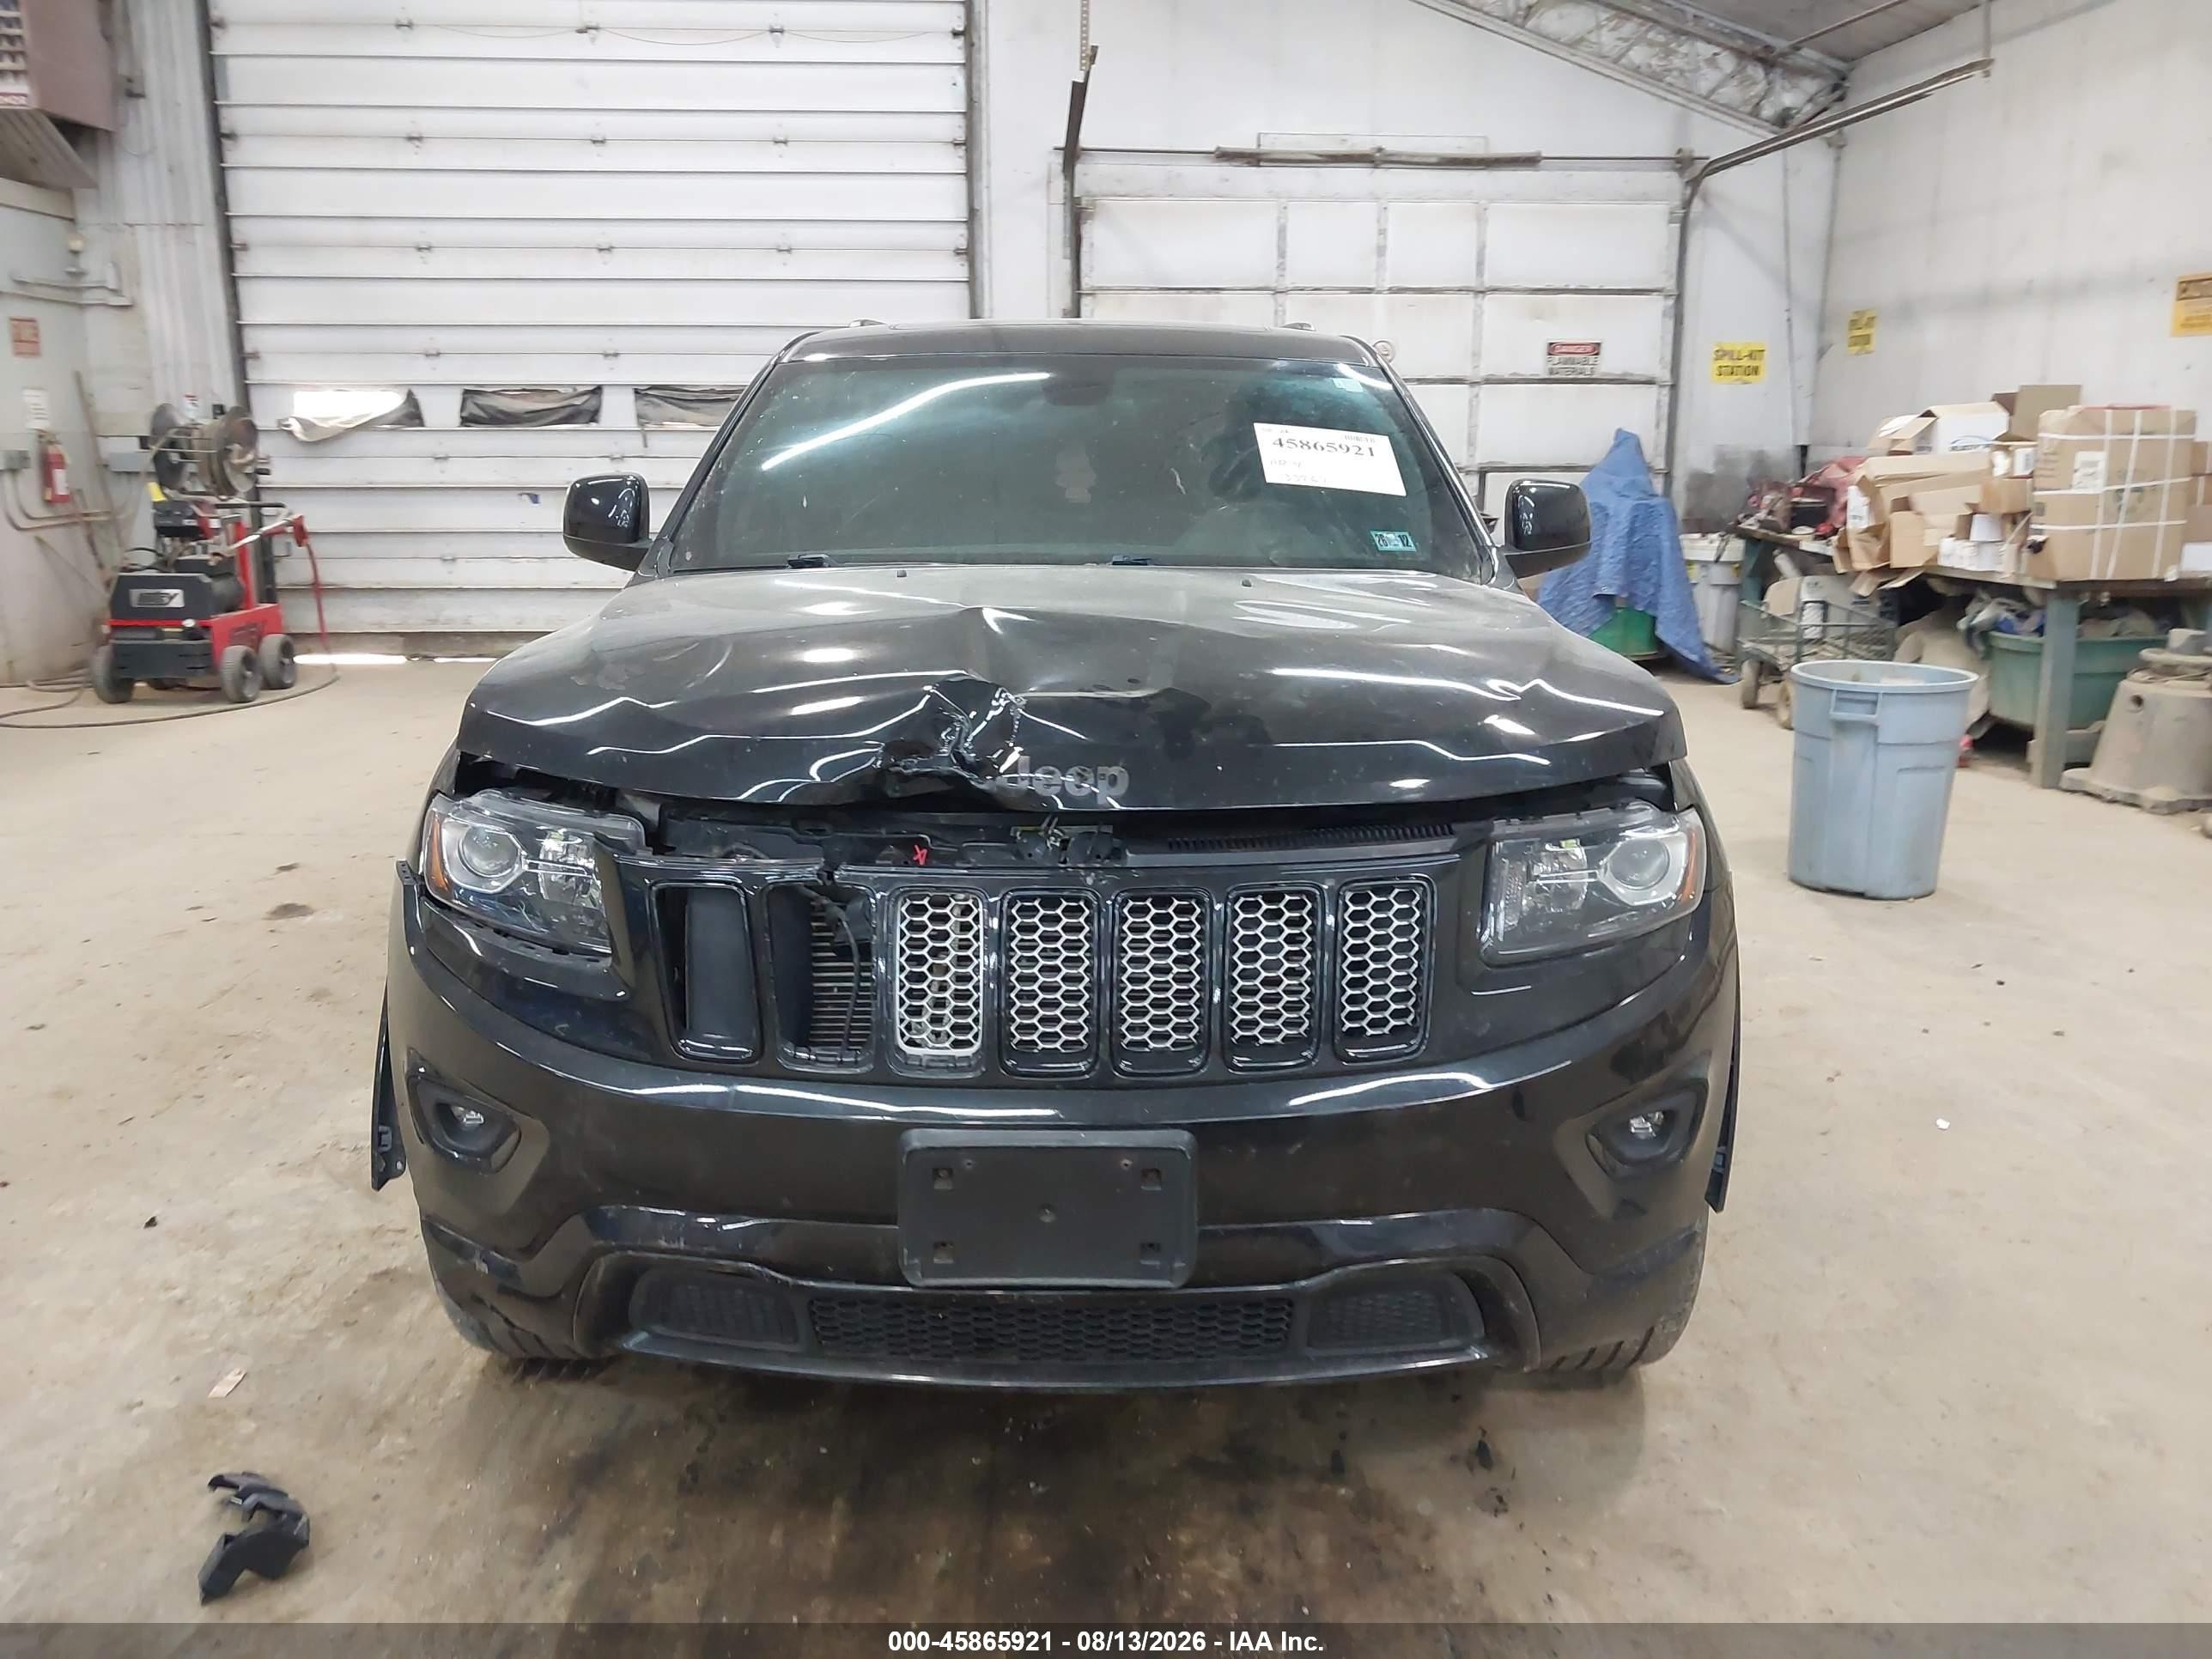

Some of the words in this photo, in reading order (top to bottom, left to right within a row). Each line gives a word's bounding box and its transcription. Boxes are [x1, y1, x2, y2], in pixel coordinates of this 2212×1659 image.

[1714, 349, 1765, 361] SPILL-KIT
[1717, 365, 1759, 376] STATION
[1272, 437, 1375, 457] 45865921
[1398, 534, 1413, 547] 12
